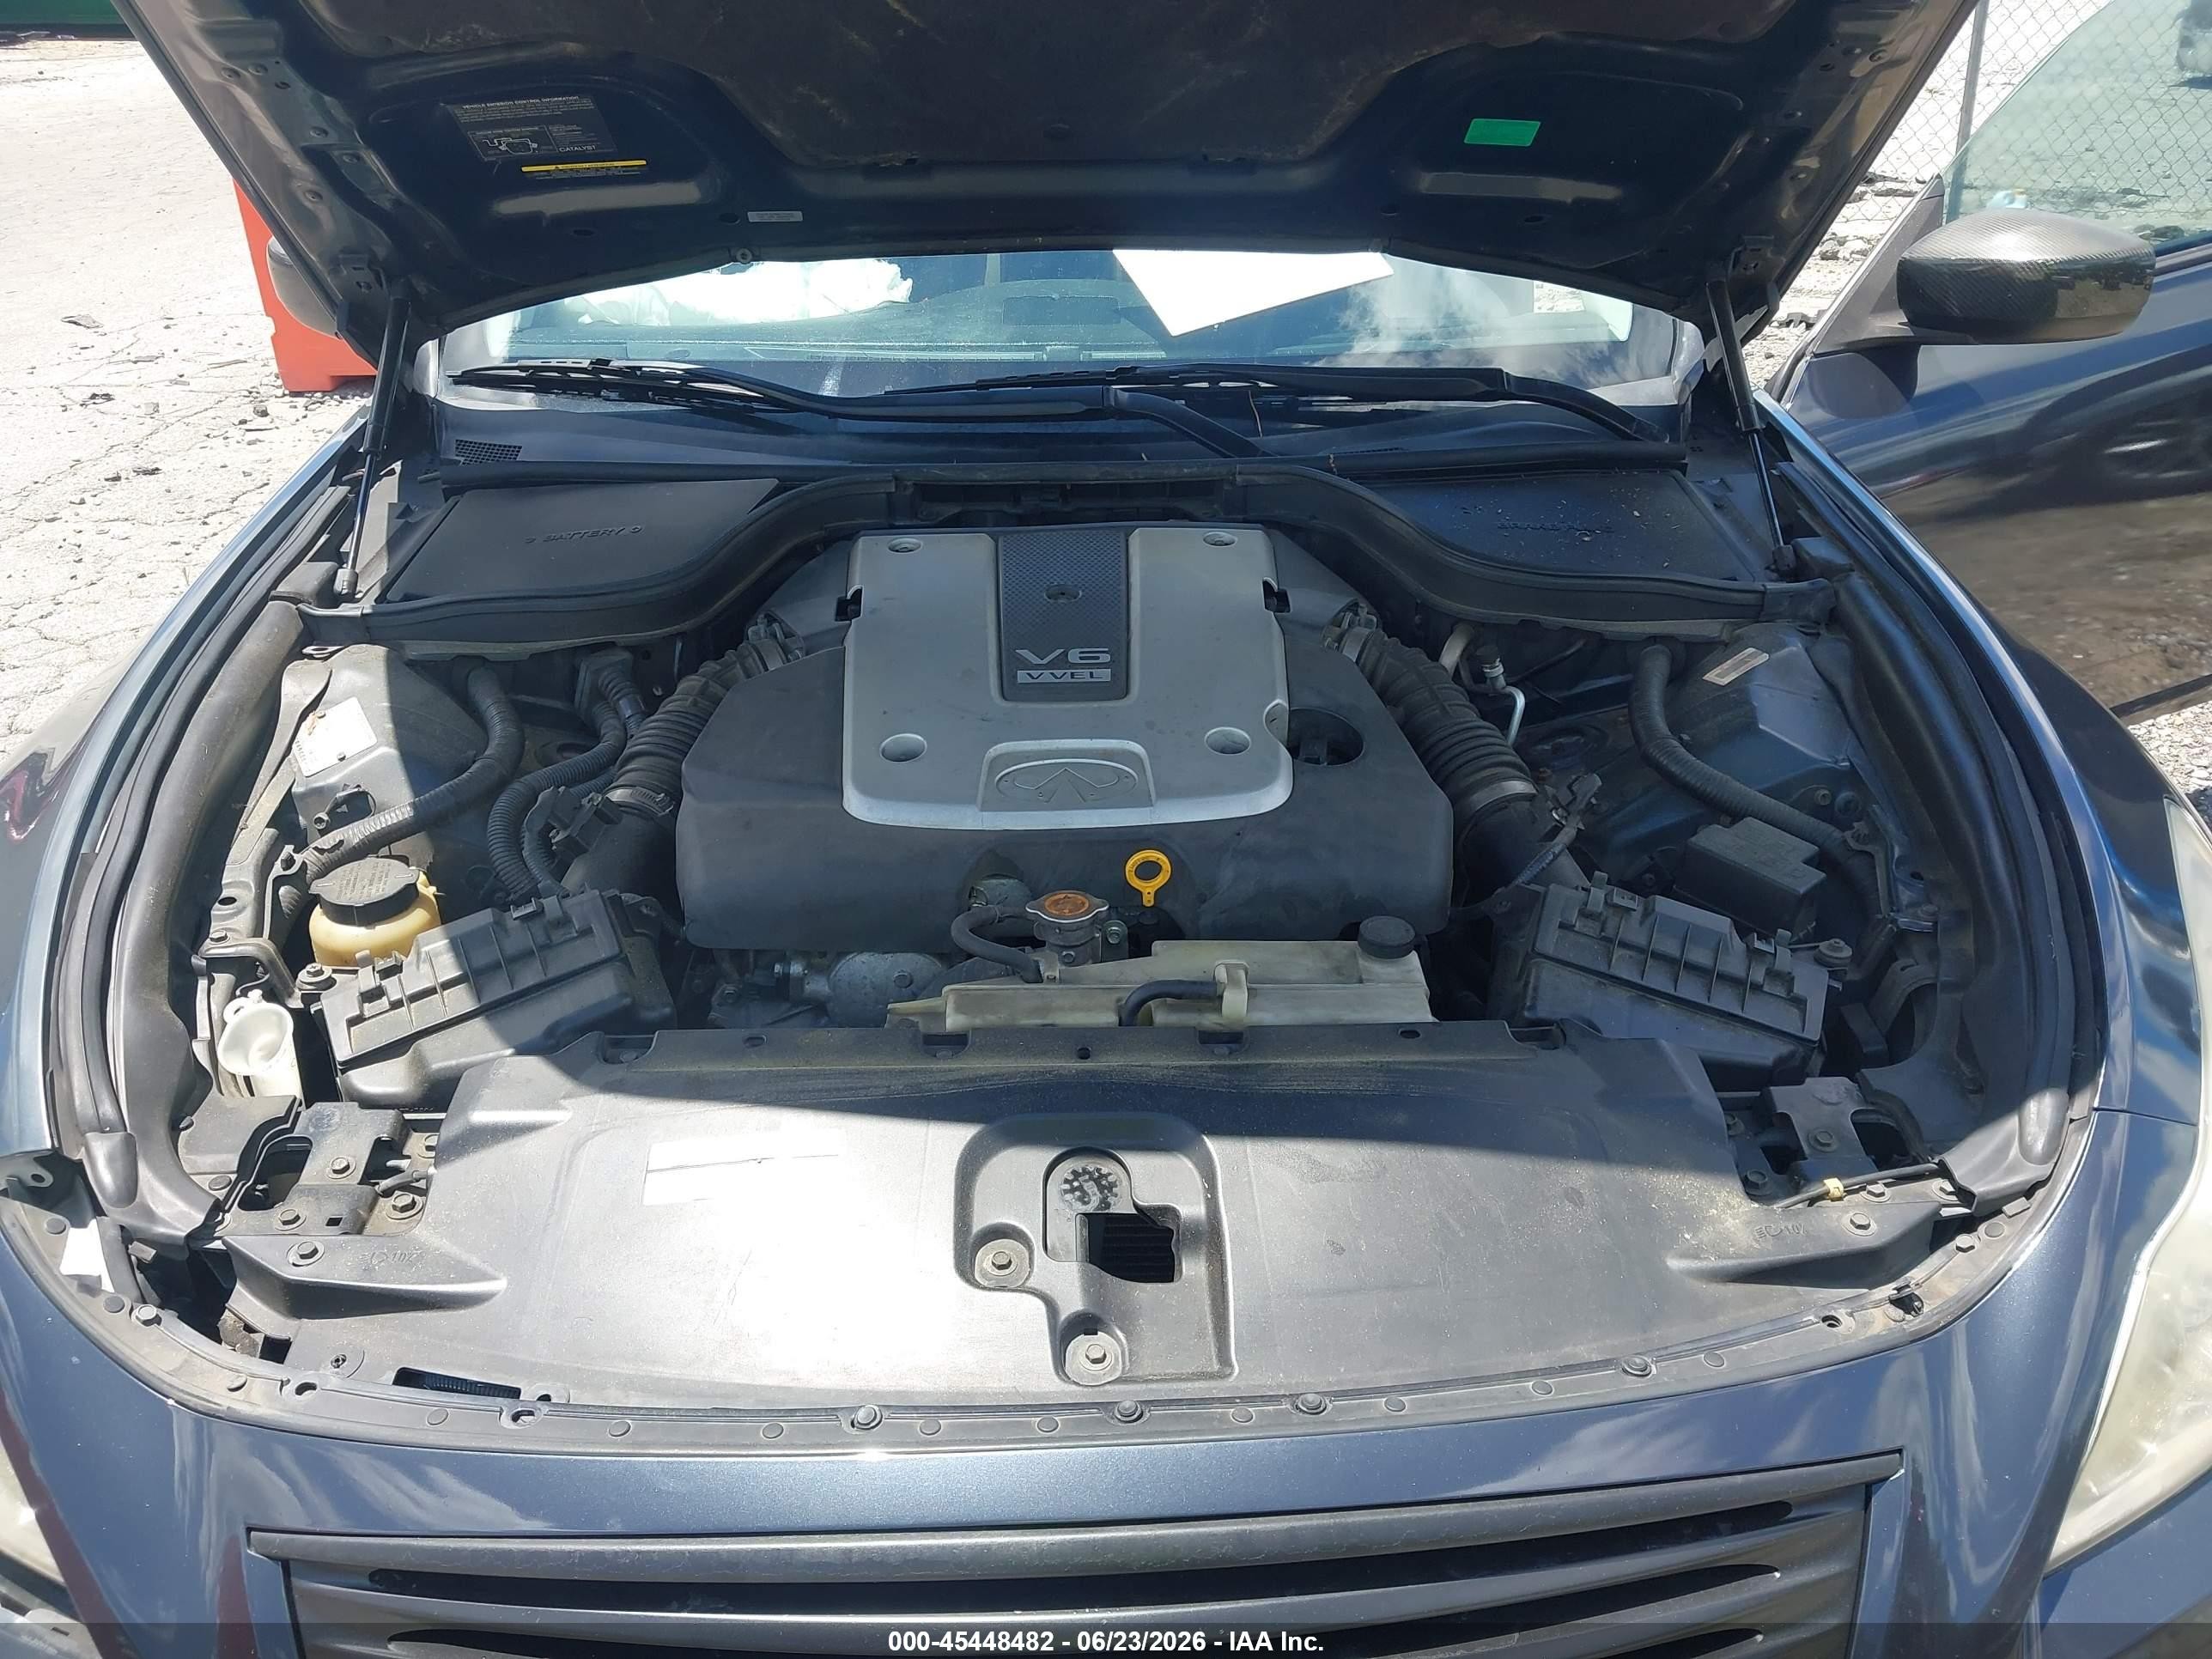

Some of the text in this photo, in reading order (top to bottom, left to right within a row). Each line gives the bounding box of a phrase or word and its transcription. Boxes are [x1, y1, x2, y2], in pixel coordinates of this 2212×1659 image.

[543, 526, 626, 543] BATTERY
[1015, 647, 1111, 665] V6
[1025, 672, 1107, 680] VVEL
